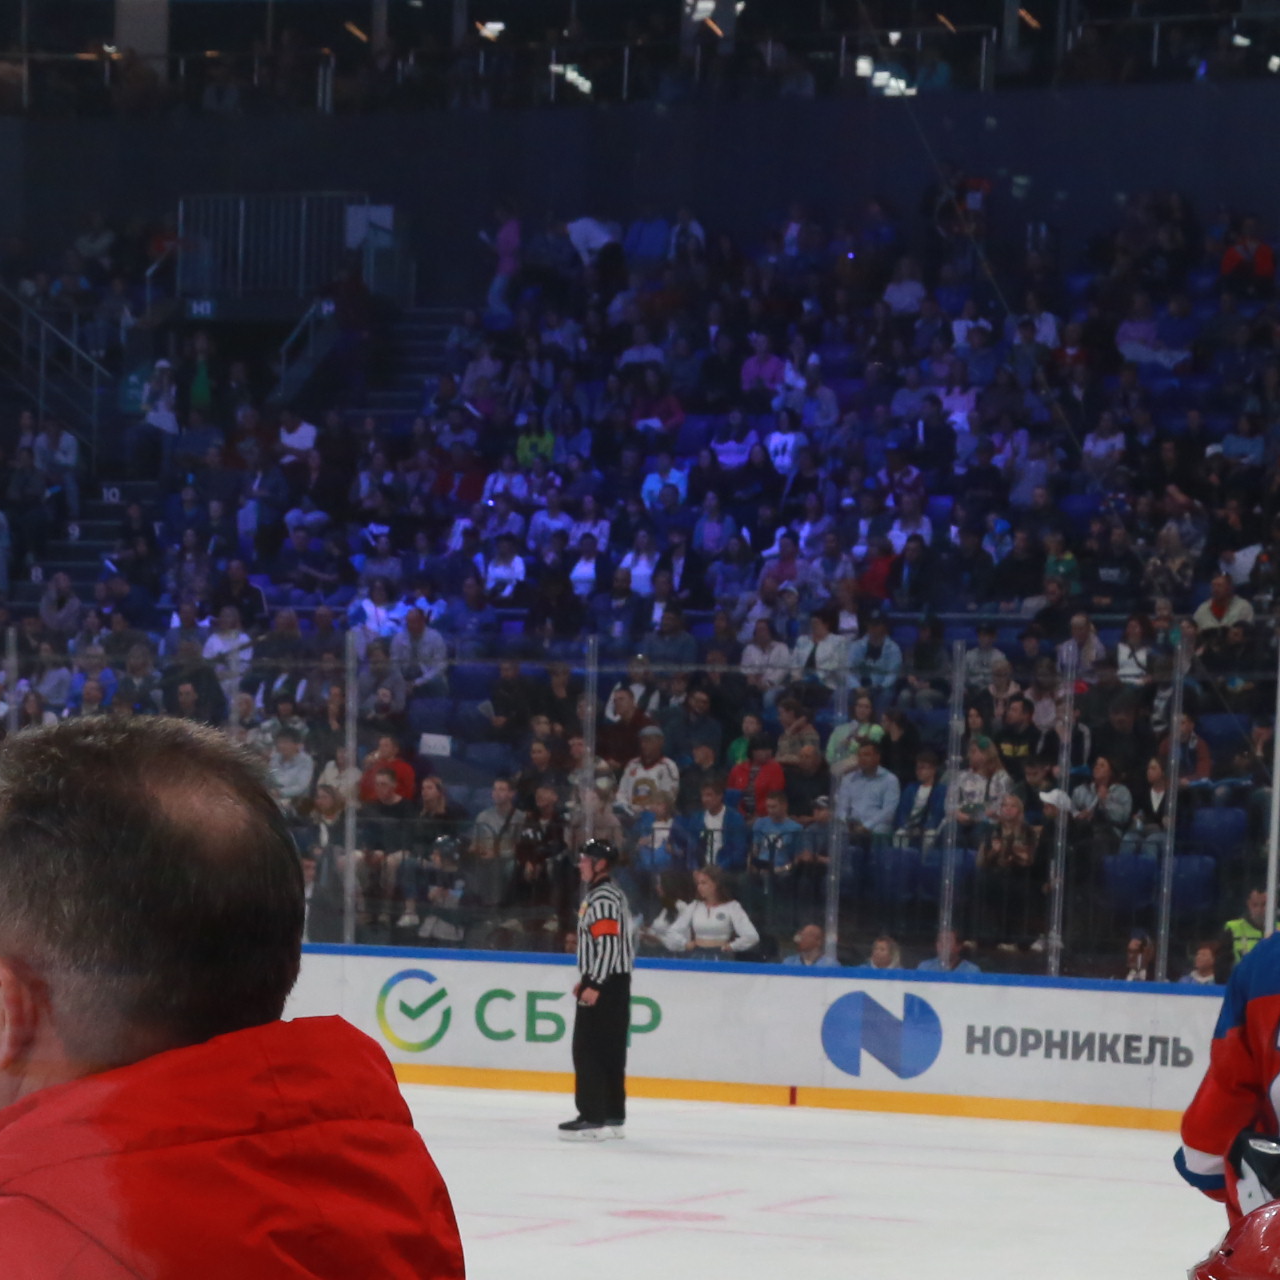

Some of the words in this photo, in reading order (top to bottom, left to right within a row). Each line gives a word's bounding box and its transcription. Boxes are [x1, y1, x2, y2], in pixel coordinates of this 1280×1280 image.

[102, 487, 120, 503] 10
[474, 988, 663, 1047] СБР
[965, 1023, 1194, 1069] НОРНИКЕЛЬ
